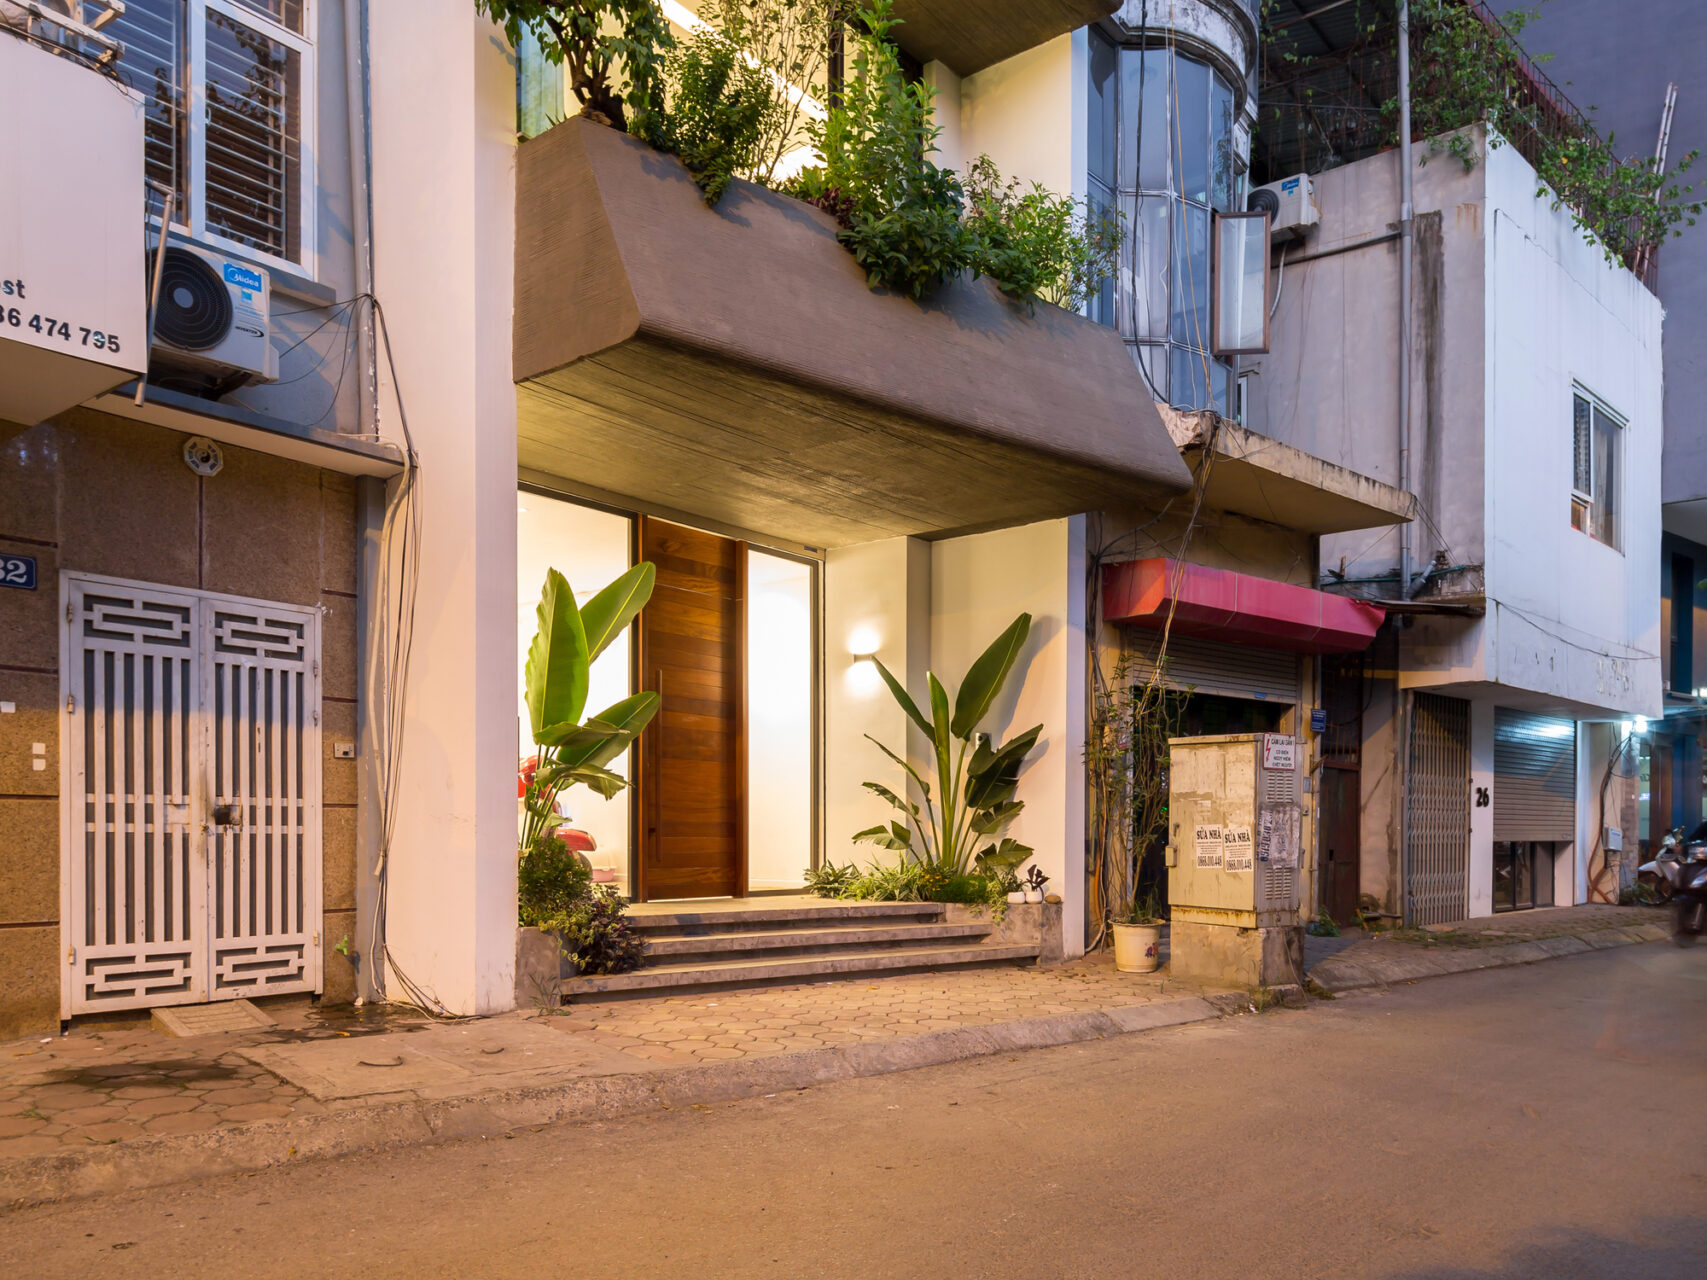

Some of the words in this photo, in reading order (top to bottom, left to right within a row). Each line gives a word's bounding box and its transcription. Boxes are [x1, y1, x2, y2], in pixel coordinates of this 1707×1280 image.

[0, 279, 25, 299] st
[233, 273, 259, 287] Midea
[28, 314, 71, 341] 474
[79, 326, 120, 353] 795
[0, 558, 27, 584] 2
[1475, 787, 1490, 808] 26
